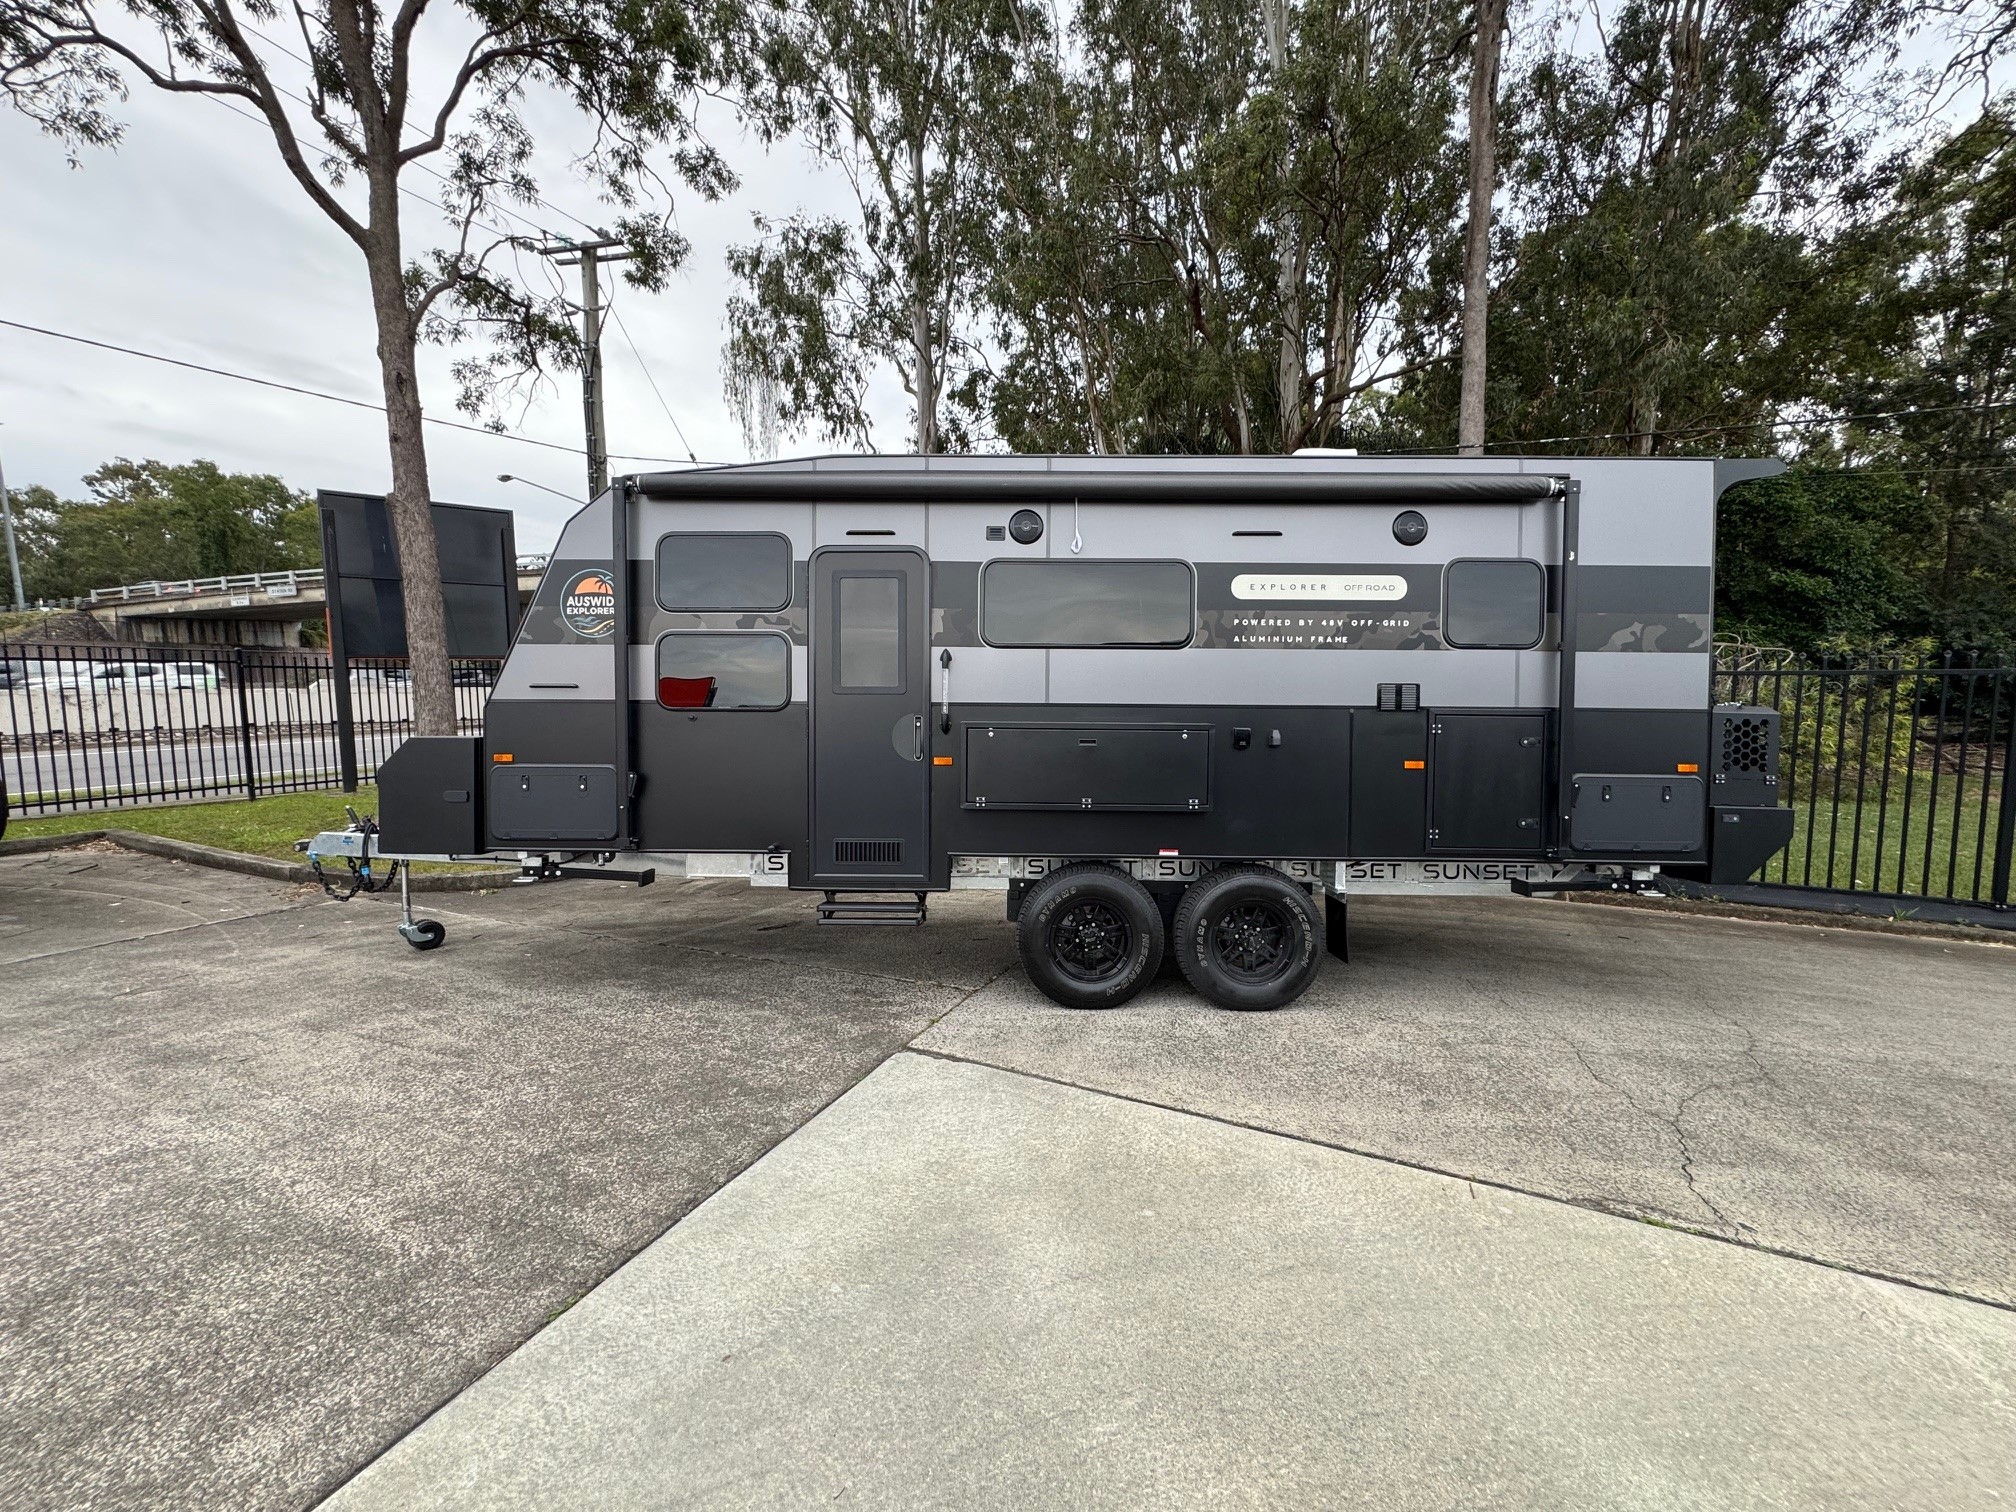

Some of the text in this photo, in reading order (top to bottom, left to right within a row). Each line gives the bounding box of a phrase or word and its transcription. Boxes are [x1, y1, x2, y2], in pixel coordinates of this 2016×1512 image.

[1249, 583, 1396, 592] EXPLORER OFF ROAD
[1233, 618, 1410, 627] POWERED BY 48V OFF-GRID
[1233, 635, 1348, 644] ALUMINIUM FRAME
[1423, 863, 1535, 880] SUNSET
